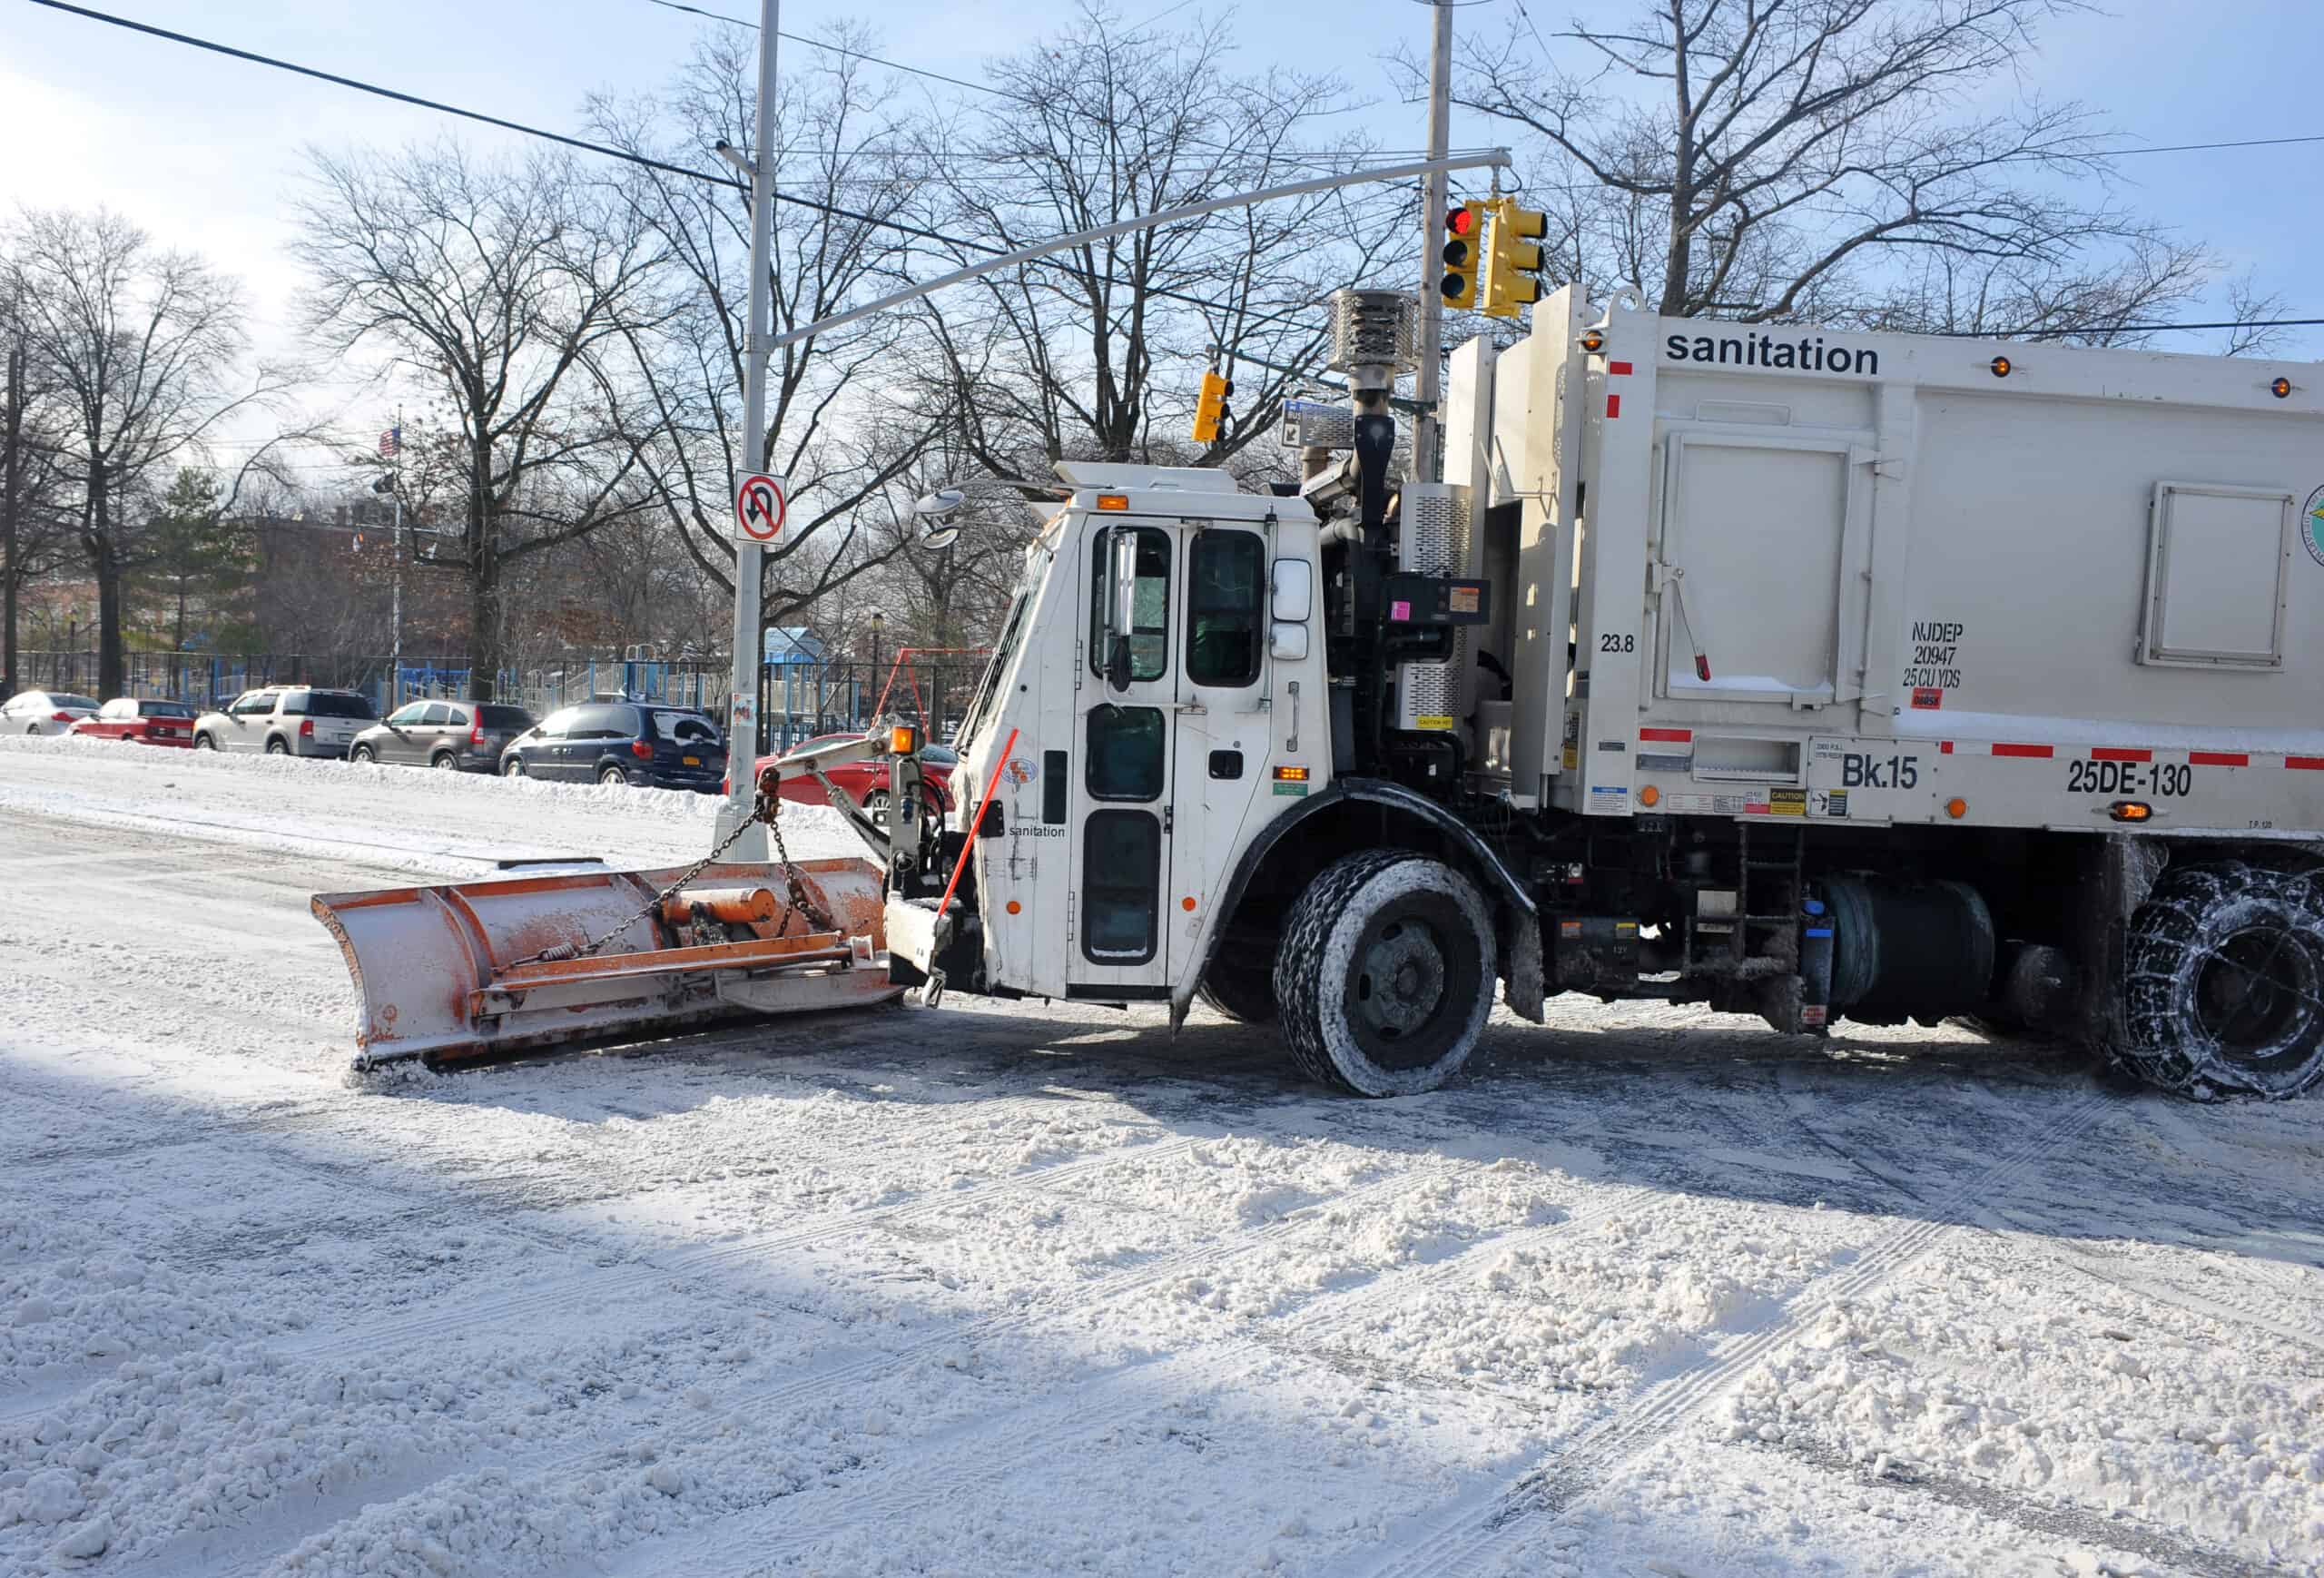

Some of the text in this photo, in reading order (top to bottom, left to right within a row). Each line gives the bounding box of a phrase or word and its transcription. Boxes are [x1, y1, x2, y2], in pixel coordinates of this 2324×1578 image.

[1666, 332, 1879, 375] sanitation
[1912, 621, 1964, 643] NJDEP
[1600, 633, 1634, 654] 23.8
[1914, 646, 1957, 666] 20947
[1903, 667, 1961, 689] 25 CU YDS
[1843, 754, 1918, 789] Bk.15
[2067, 760, 2191, 797] 25DE-130
[1771, 791, 1806, 801] CAUTION
[1009, 824, 1066, 838] sanitation
